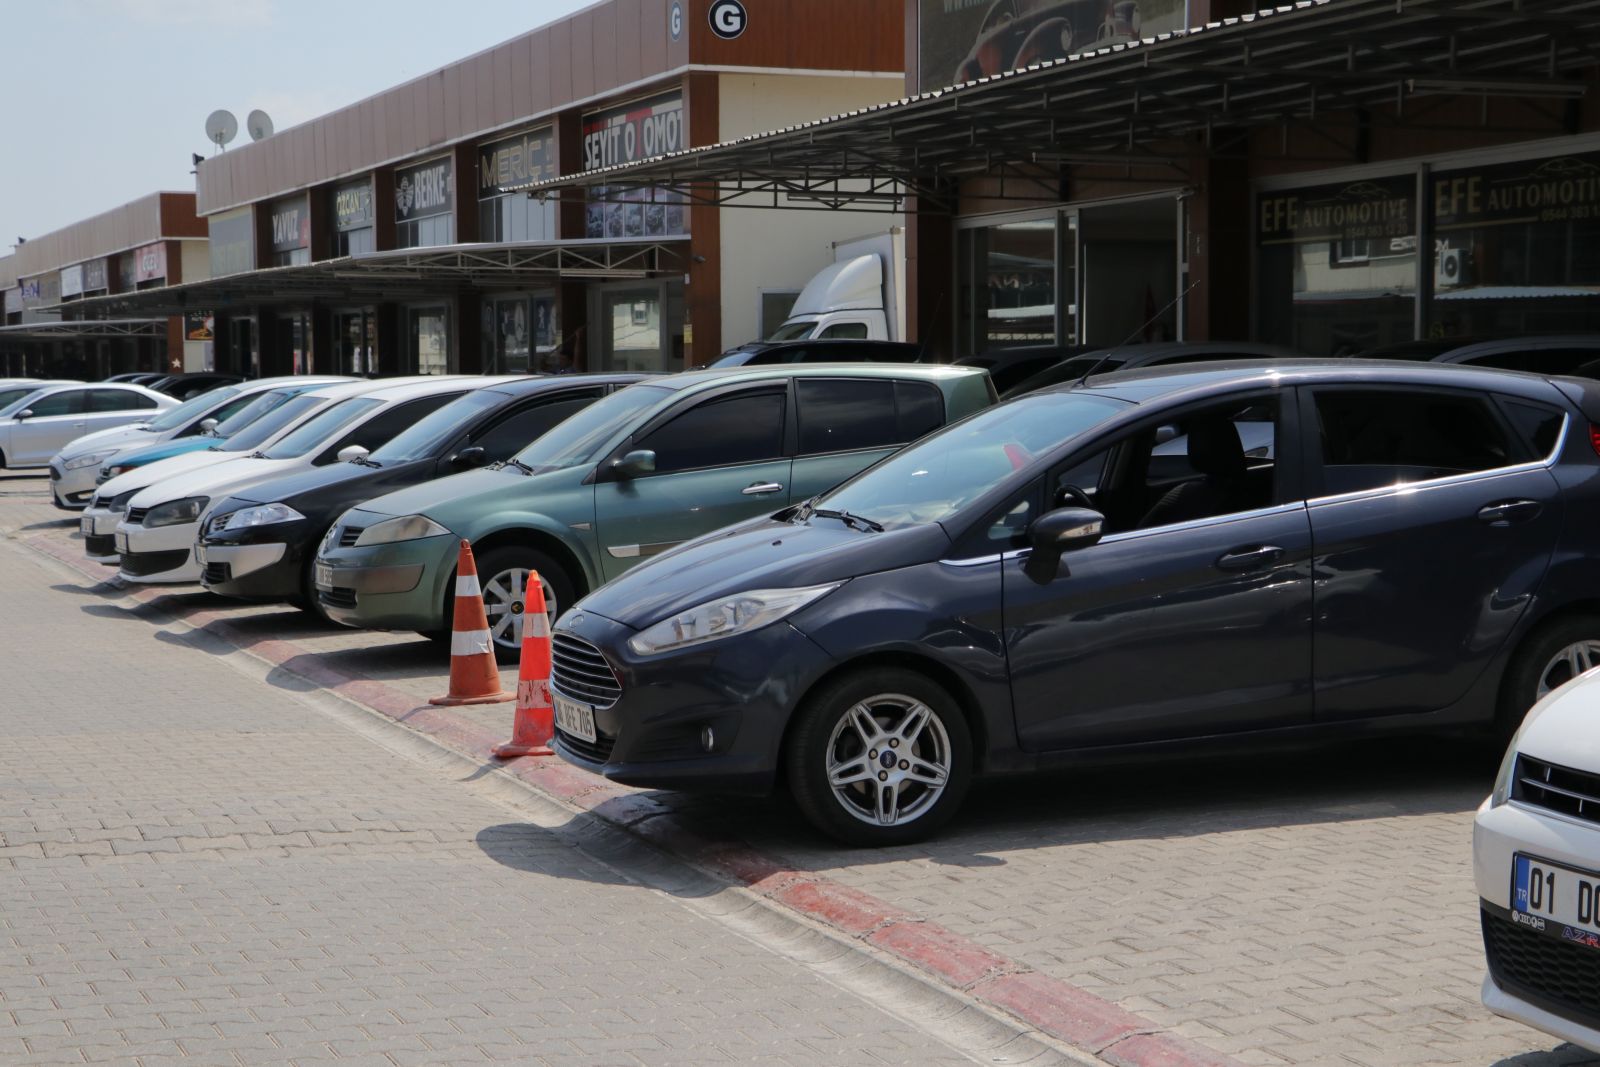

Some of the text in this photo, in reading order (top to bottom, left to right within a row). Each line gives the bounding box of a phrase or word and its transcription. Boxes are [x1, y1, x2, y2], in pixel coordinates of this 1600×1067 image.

[671, 7, 681, 35] G
[715, 4, 741, 33] G
[414, 165, 446, 210] BERKE
[1435, 171, 1600, 217] EFE AUTOMOTİ
[1261, 197, 1298, 232] EFE
[1517, 887, 1528, 903] TR
[1530, 867, 1555, 914] 01
